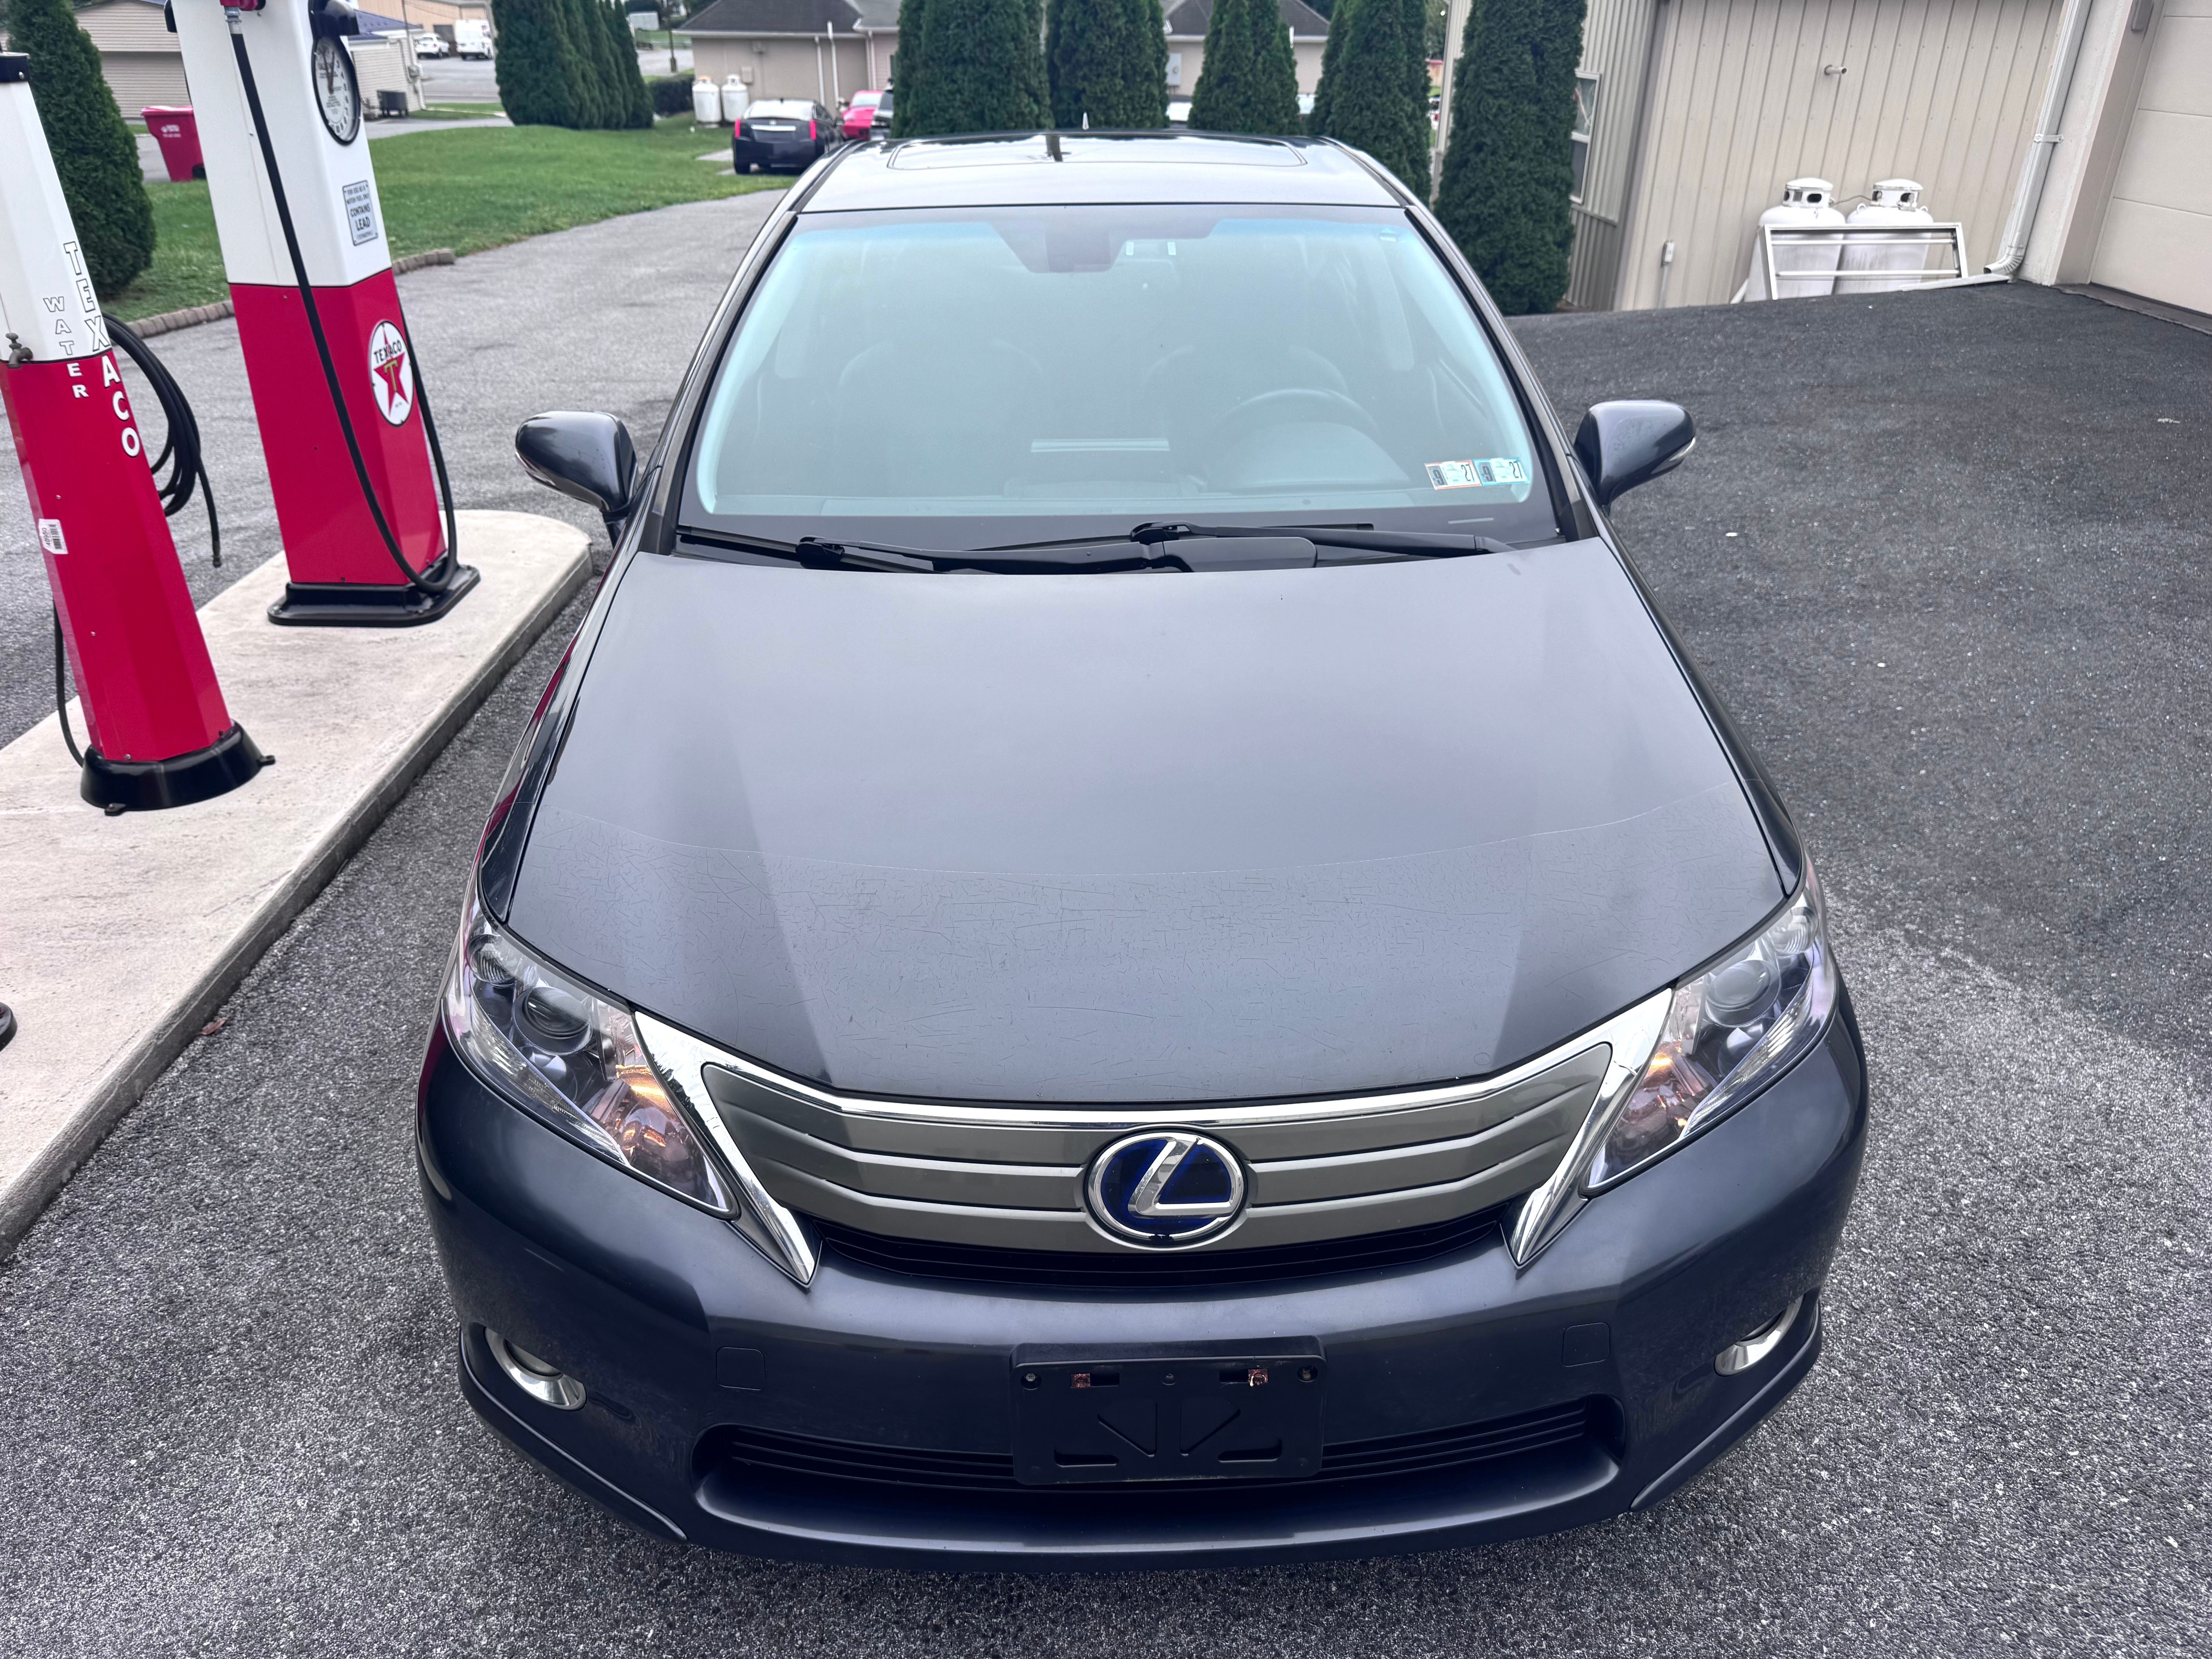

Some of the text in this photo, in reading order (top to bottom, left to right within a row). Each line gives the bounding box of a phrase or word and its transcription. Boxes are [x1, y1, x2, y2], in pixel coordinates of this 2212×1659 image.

[350, 203, 371, 217] CONTAINS
[356, 216, 371, 231] LEAD
[43, 296, 89, 398] WATER
[64, 240, 140, 457] TEXACO
[373, 340, 402, 364] TEXACO
[1460, 464, 1475, 483] 27
[1508, 461, 1522, 479] 27
